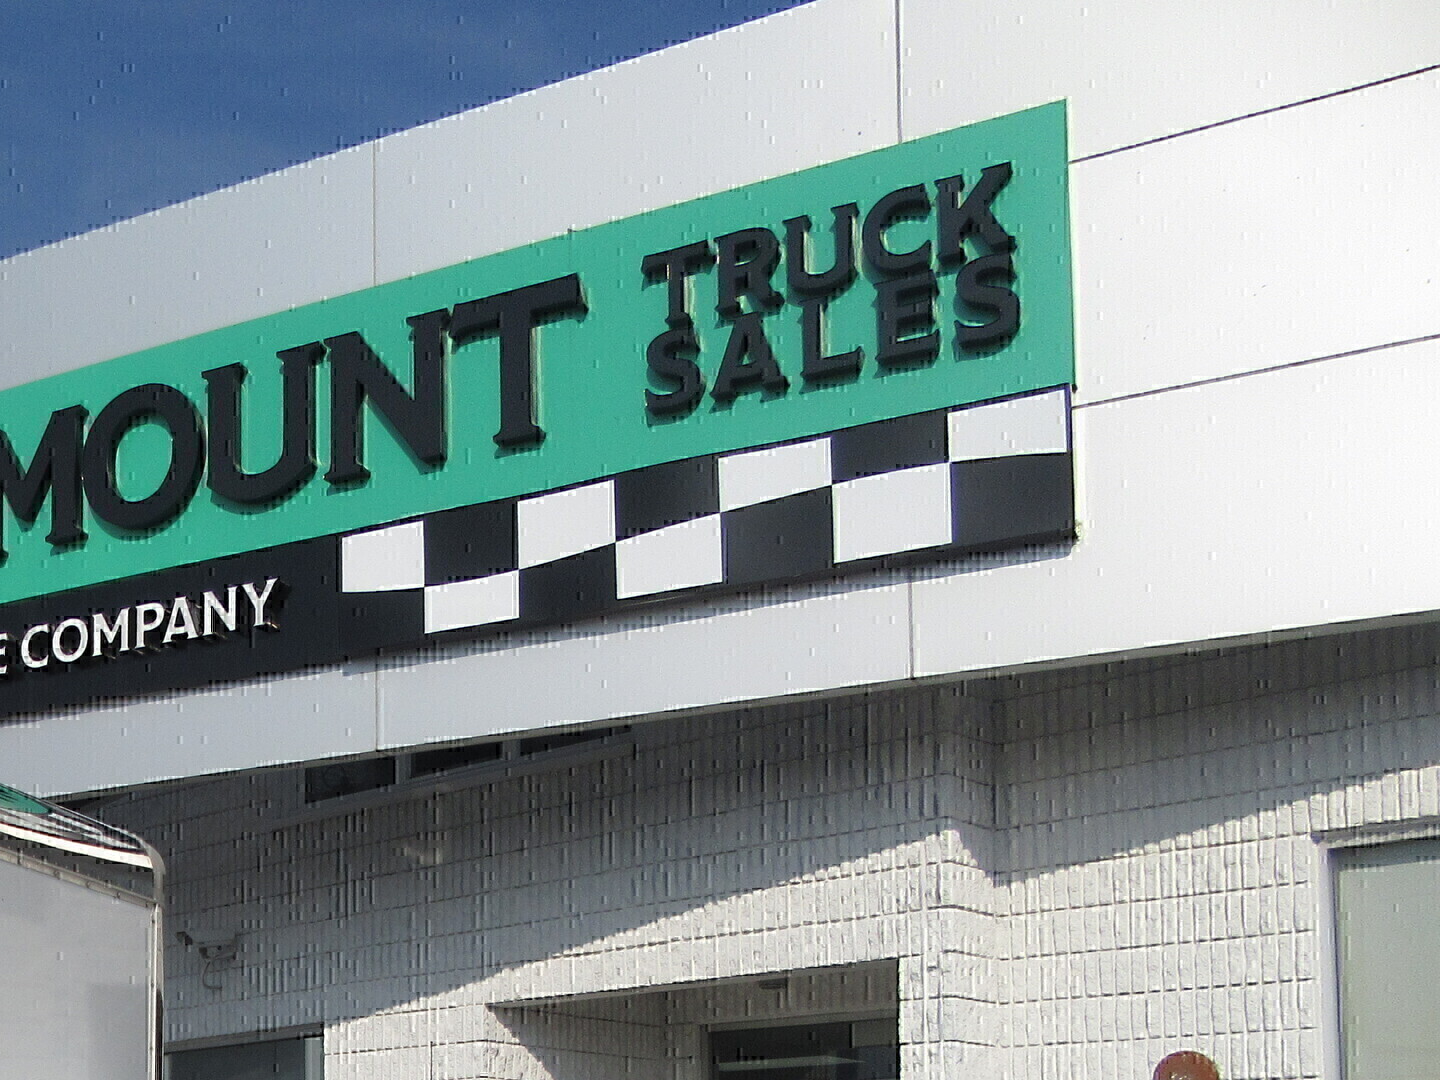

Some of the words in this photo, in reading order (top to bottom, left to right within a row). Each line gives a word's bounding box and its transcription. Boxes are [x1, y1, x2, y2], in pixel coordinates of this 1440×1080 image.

[641, 161, 1018, 330] TRUCK
[644, 252, 1021, 428] SALES
[21, 577, 279, 669] COMPANY
